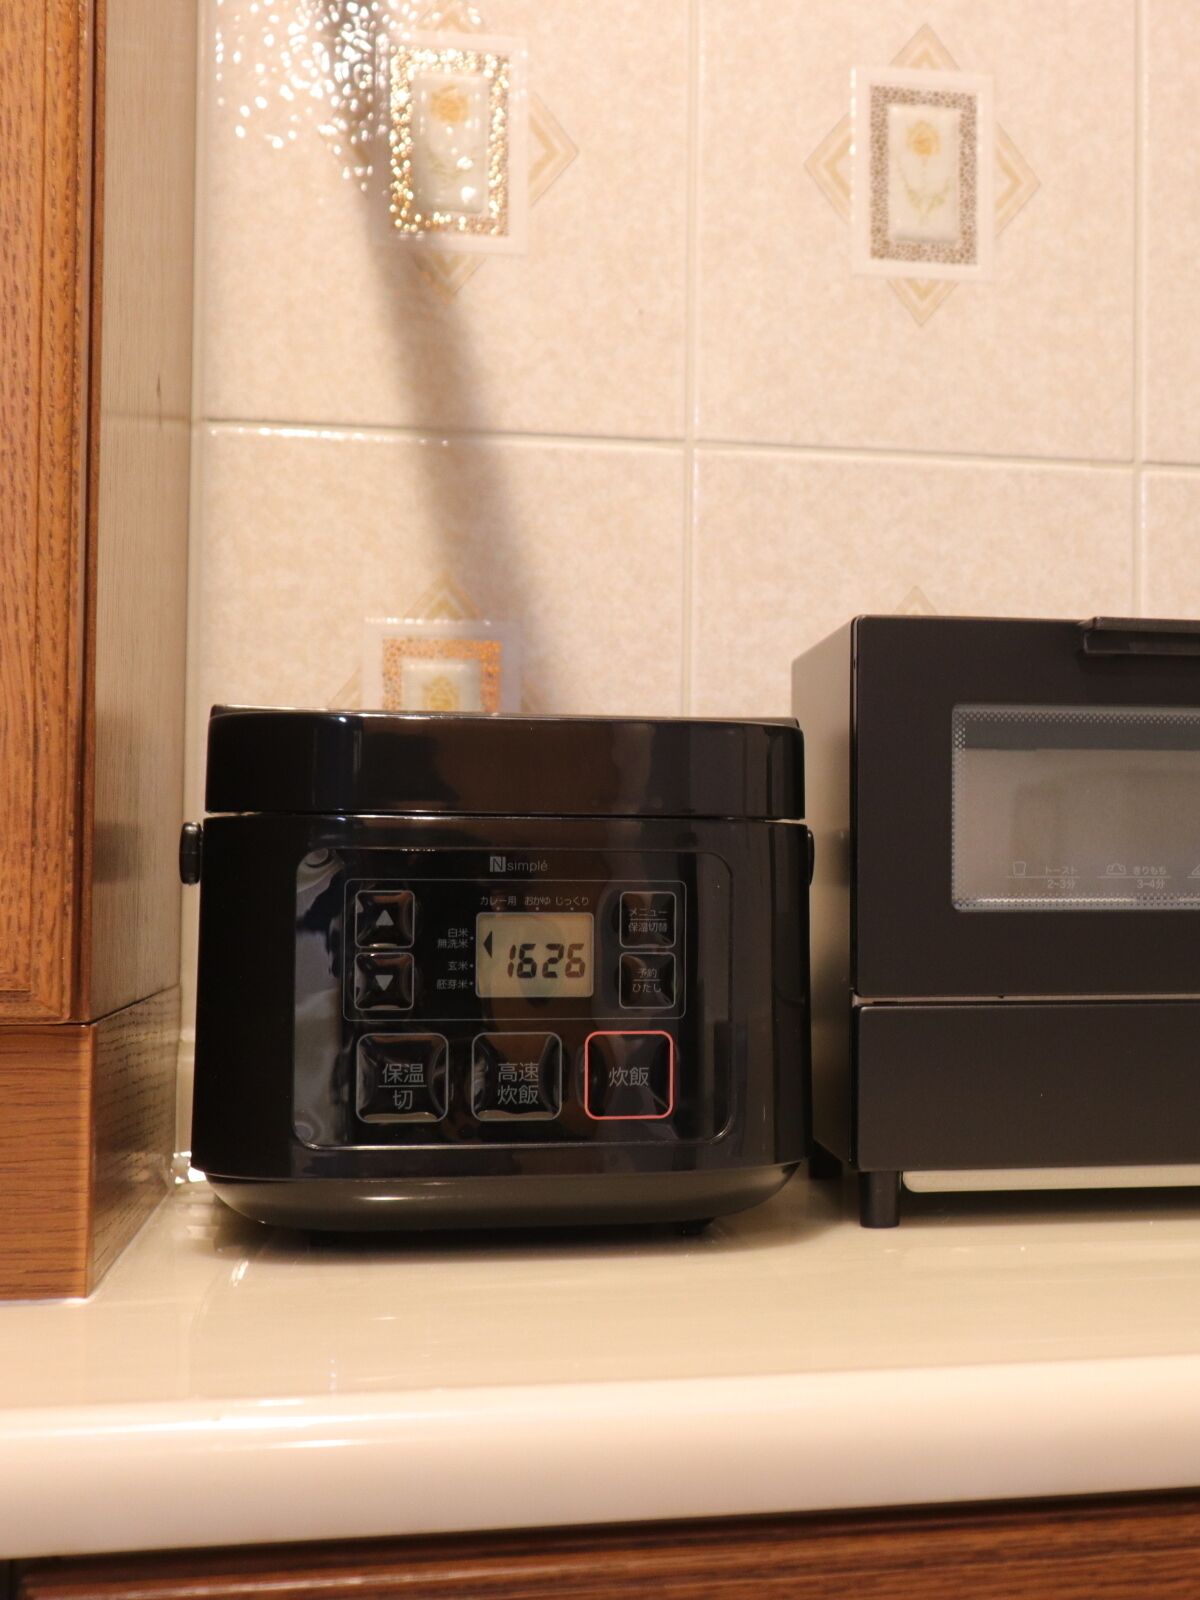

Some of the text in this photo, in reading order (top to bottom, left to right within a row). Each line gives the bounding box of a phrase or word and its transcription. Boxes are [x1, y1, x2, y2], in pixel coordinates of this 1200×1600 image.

[480, 896, 517, 906] カレー用
[524, 896, 551, 906] おかゆ
[556, 896, 589, 906] じっくり
[629, 907, 668, 917] メニュー
[628, 922, 668, 933] 保温切替
[448, 928, 468, 938] 白米
[438, 938, 468, 949] 無洗米
[448, 961, 468, 971] 玄米
[639, 968, 658, 978] 予約
[437, 979, 468, 990] 胚芽米
[632, 983, 662, 993] ひたし
[382, 1063, 425, 1084] 保温
[497, 1062, 539, 1083] 高速
[608, 1066, 650, 1088] 炊飯
[392, 1089, 415, 1111] 切
[497, 1085, 539, 1106] 炊飯
